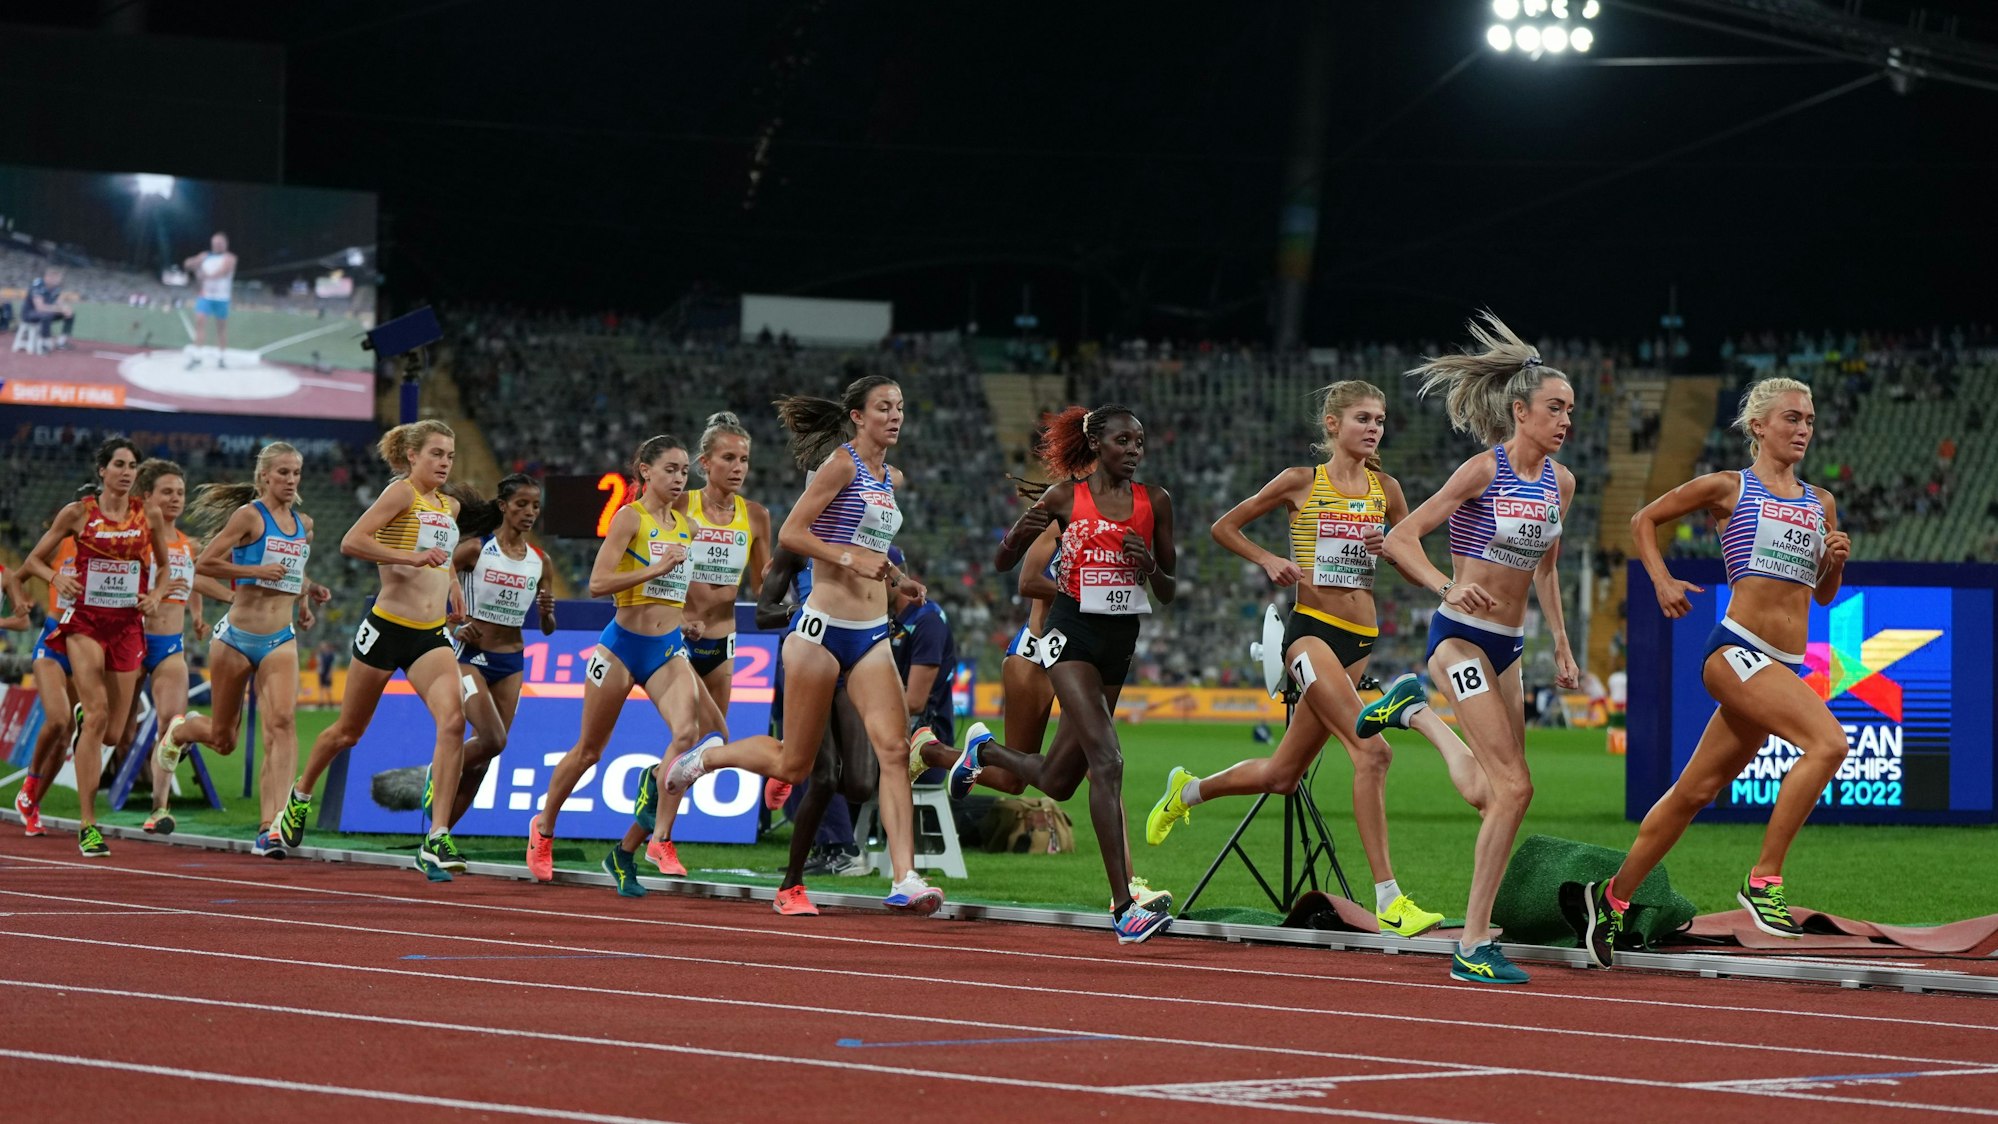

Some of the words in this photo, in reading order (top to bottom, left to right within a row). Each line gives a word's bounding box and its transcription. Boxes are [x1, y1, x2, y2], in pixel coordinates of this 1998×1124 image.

[881, 511, 893, 524] 437
[1497, 502, 1546, 519] SPAR
[1763, 503, 1817, 528] SPAR
[433, 530, 448, 542] 450
[1518, 523, 1542, 538] 439
[1784, 528, 1811, 547] 436
[268, 540, 301, 555] SPAR
[856, 534, 887, 549] MUNICH
[707, 546, 729, 558] 494
[1341, 544, 1367, 558] 448
[1772, 540, 1814, 559] HARRISON
[280, 557, 297, 568] 427
[1489, 548, 1529, 568] MUNICH
[91, 561, 129, 573] SPAR
[1755, 557, 1798, 576] MUNICH
[104, 576, 124, 585] 414
[485, 571, 526, 587] SPAR
[1084, 571, 1135, 584] SPAR
[1319, 574, 1358, 585] MUNICH
[499, 589, 519, 601] 431
[647, 586, 679, 598] MUNICH
[1106, 591, 1132, 603] 497
[89, 597, 118, 605] MUNICH
[477, 609, 509, 623] MUNICH
[801, 614, 822, 637] 10
[357, 626, 371, 642] 3
[1022, 636, 1037, 657] 5
[590, 657, 605, 680] 16
[1452, 666, 1482, 694] 18
[1840, 781, 1902, 806] 2022
